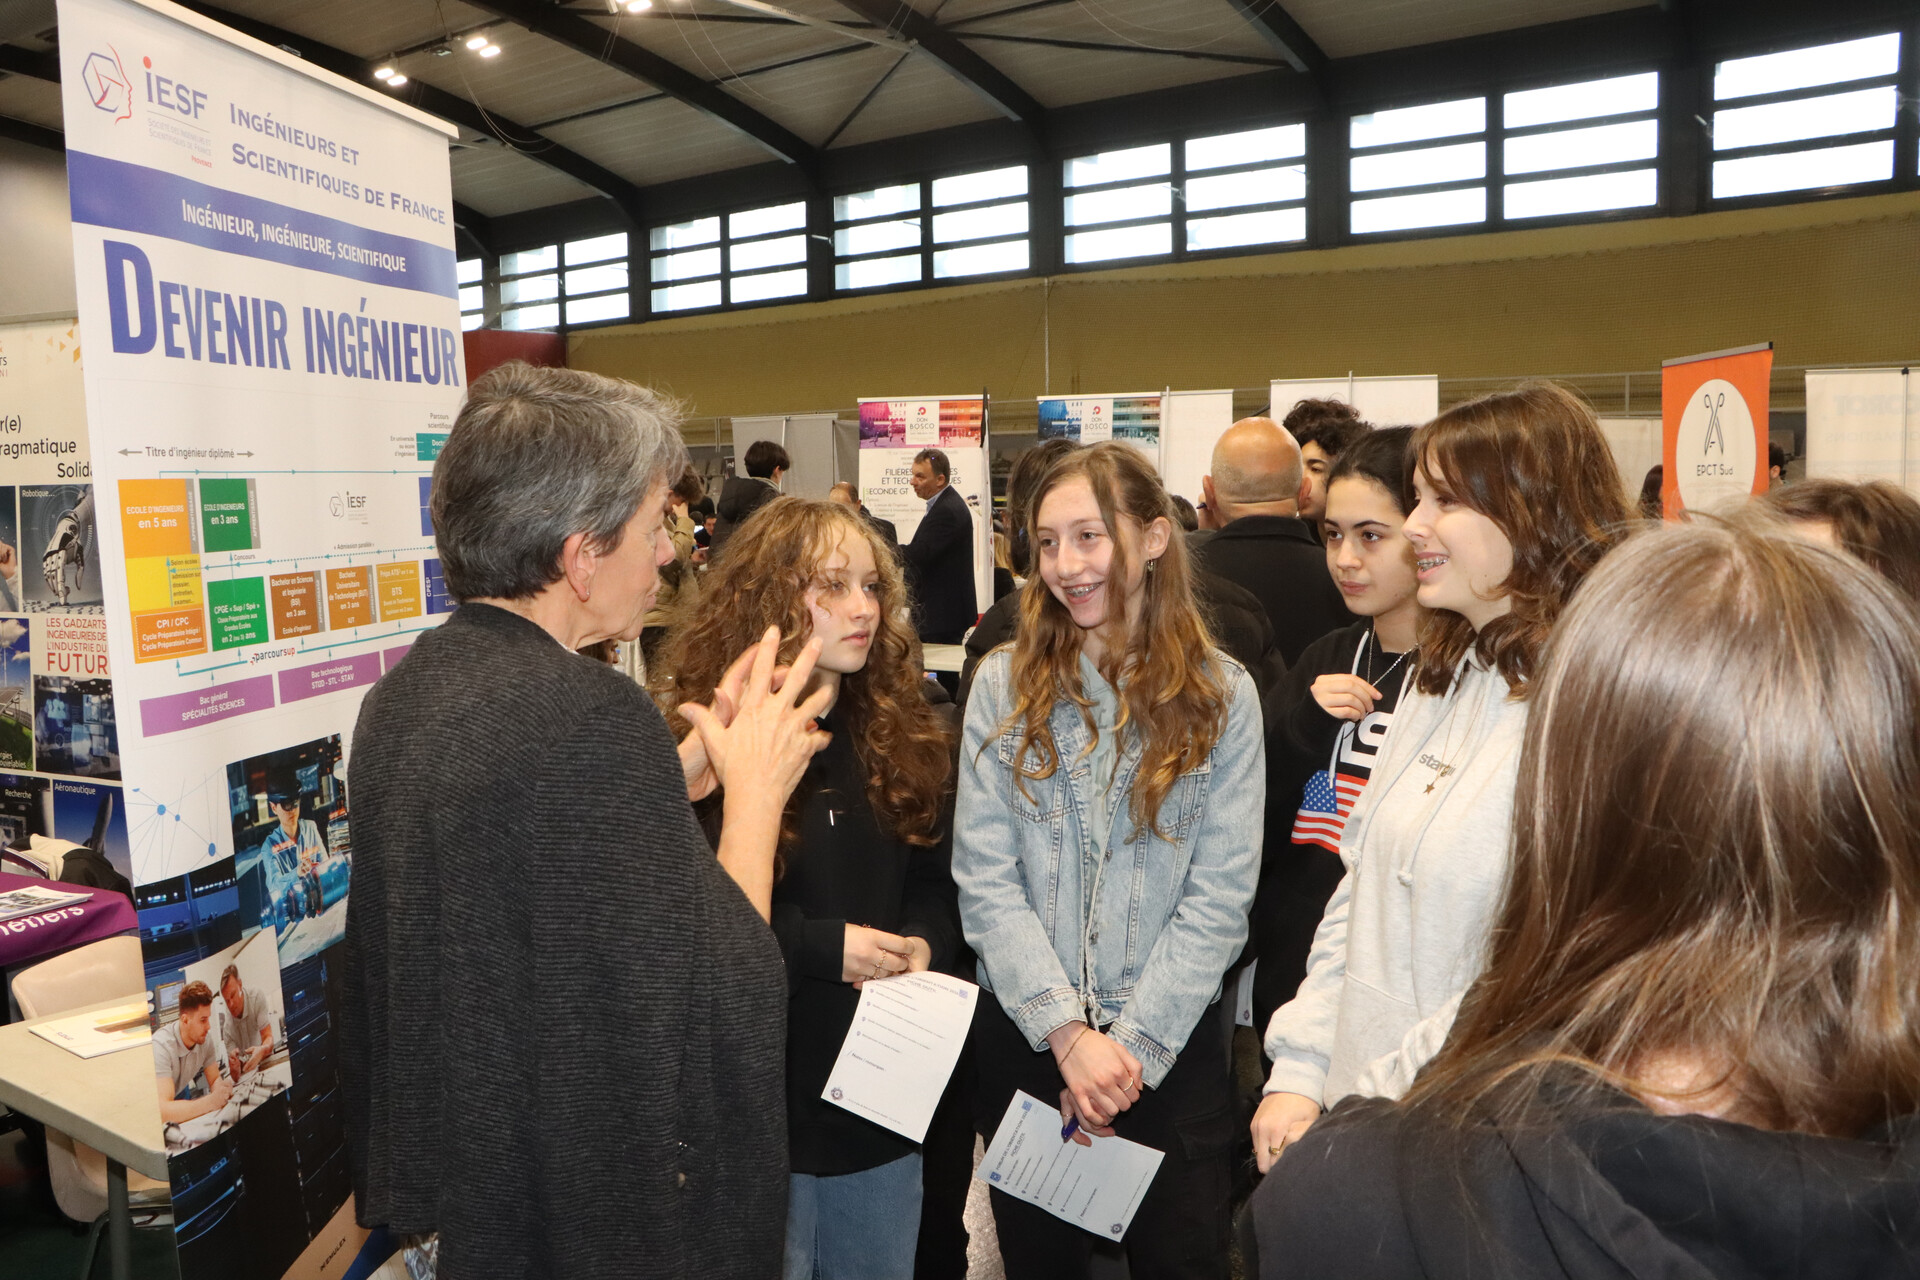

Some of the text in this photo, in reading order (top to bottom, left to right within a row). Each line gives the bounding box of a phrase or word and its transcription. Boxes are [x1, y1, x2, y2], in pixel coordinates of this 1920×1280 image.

[230, 103, 360, 167] INGÉNIEURS ET
[232, 142, 446, 225] SCIENTIFIQUES DE FRANCE
[182, 199, 407, 273] INGÉNIEUR, INGÉNIEURE, SCIENTIFIQUE
[102, 239, 460, 388] DEVENIR INGÉNIEUR
[909, 422, 935, 430] BOSCO
[1084, 422, 1109, 431] BOSCO
[145, 446, 235, 460] Titre d'ingénieur diplômé
[1696, 463, 1718, 477] EPCT
[881, 477, 890, 485] ET
[898, 488, 909, 496] GT
[138, 517, 178, 529] en 5 ans
[210, 514, 239, 525] en 3 ans
[233, 553, 256, 562] Concours
[46, 617, 107, 630] LES GADZARTS
[156, 619, 170, 629] CPI
[175, 616, 190, 627] CPC
[46, 641, 107, 653] L'INDUSTRIE DU
[254, 647, 296, 662] parcoursup
[47, 652, 109, 675] FUTUR
[310, 671, 320, 679] Bac
[199, 696, 210, 706] Bac
[218, 698, 246, 713] SCIENCES
[54, 782, 96, 796] Aéronautique
